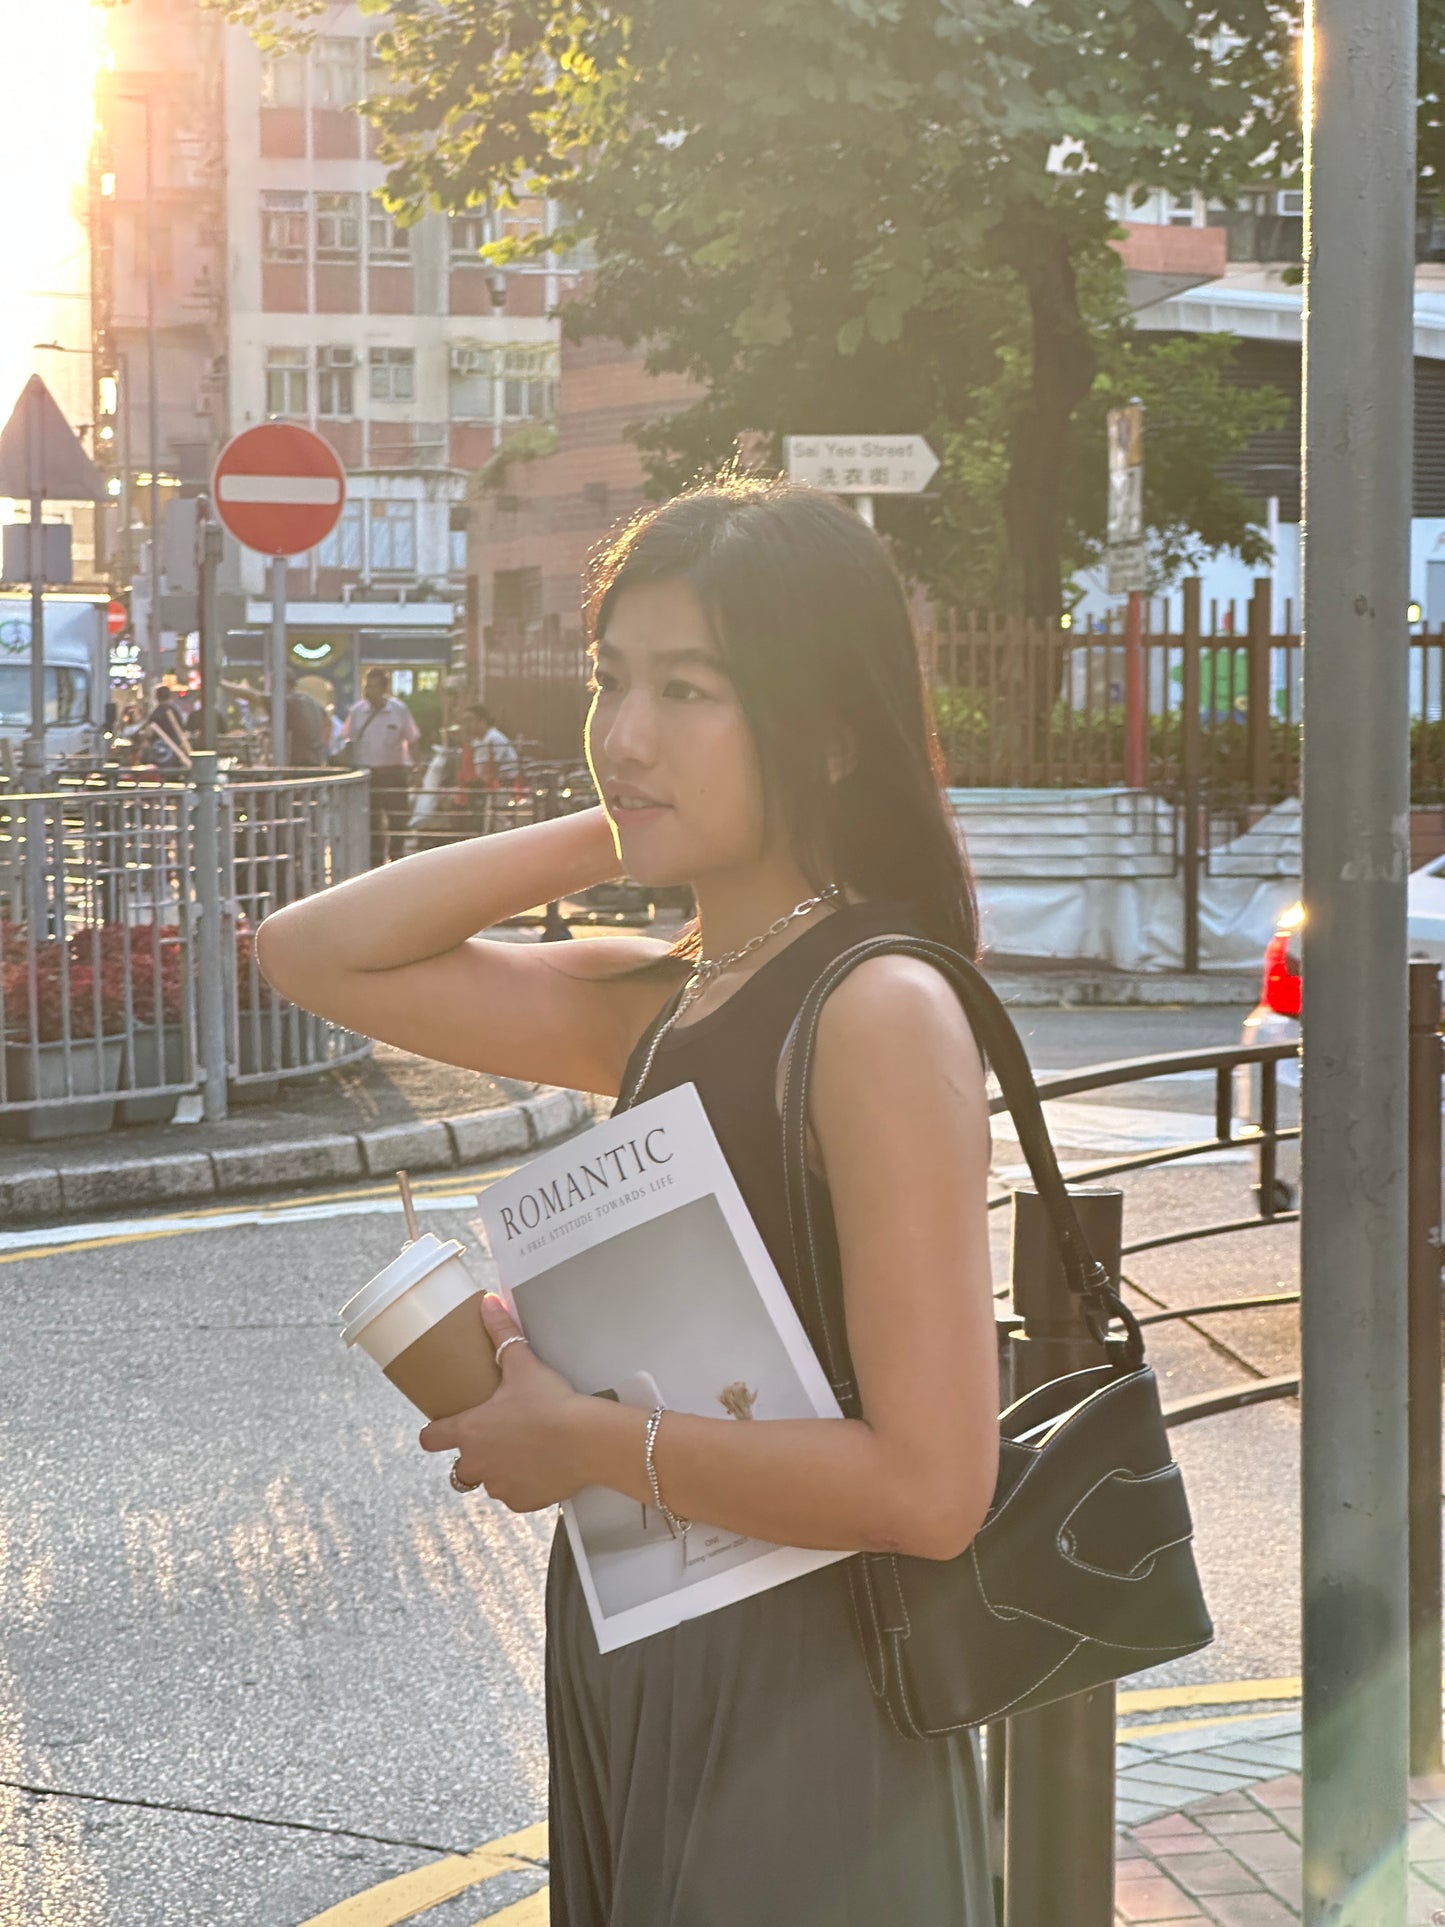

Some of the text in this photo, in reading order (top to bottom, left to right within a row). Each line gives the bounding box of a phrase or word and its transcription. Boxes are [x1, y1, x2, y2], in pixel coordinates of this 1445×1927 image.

[794, 441, 913, 458] Sai Yee Street
[500, 1128, 674, 1240] ROMANTIC
[527, 1236, 547, 1253] FREE
[549, 1212, 594, 1241] ATTITUDE
[595, 1187, 647, 1218] TOWARDS
[649, 1174, 675, 1193] LIFE
